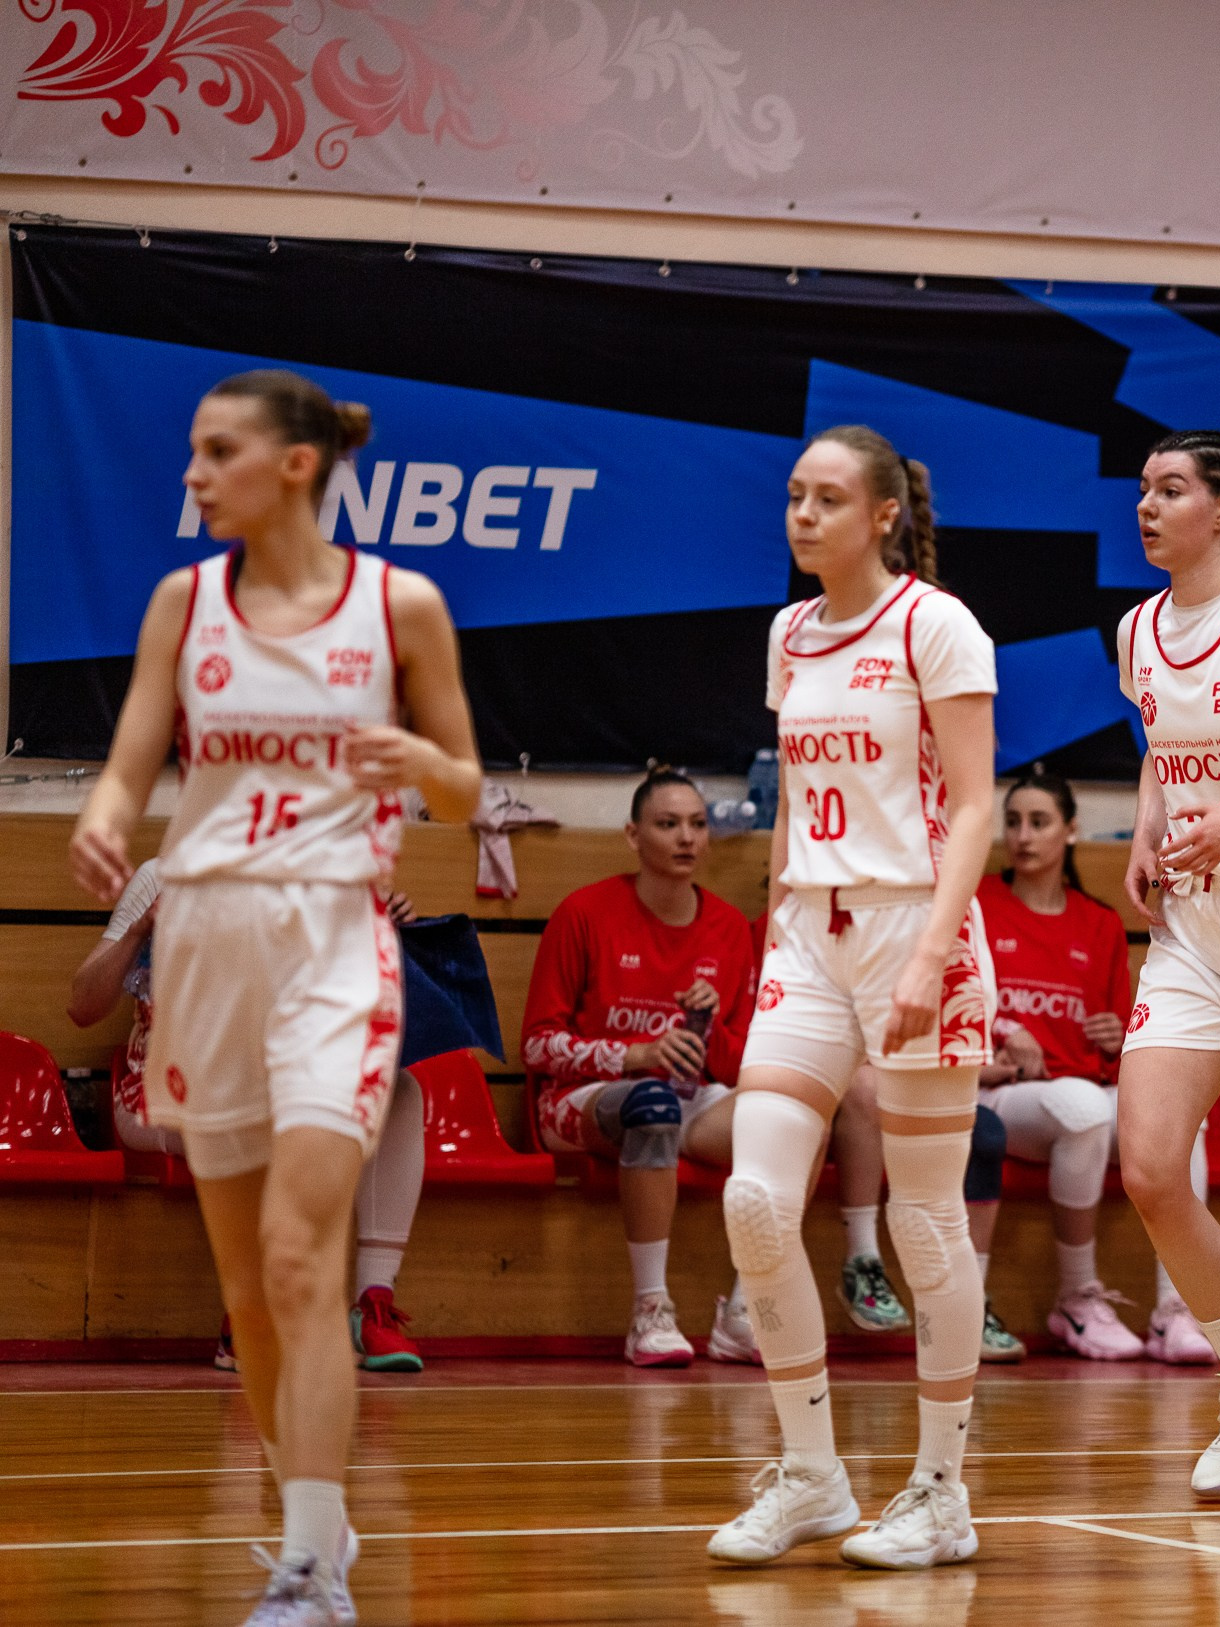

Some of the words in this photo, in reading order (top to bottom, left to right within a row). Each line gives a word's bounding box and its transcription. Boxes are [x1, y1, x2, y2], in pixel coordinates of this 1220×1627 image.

[176, 461, 598, 551] NBET
[326, 649, 373, 666] FON
[854, 657, 893, 672] FON
[328, 668, 372, 687] BET
[849, 675, 892, 689] BET
[1151, 738, 1214, 749] БАСКЕТБОЛЬНЫЙ
[806, 787, 846, 841] 30
